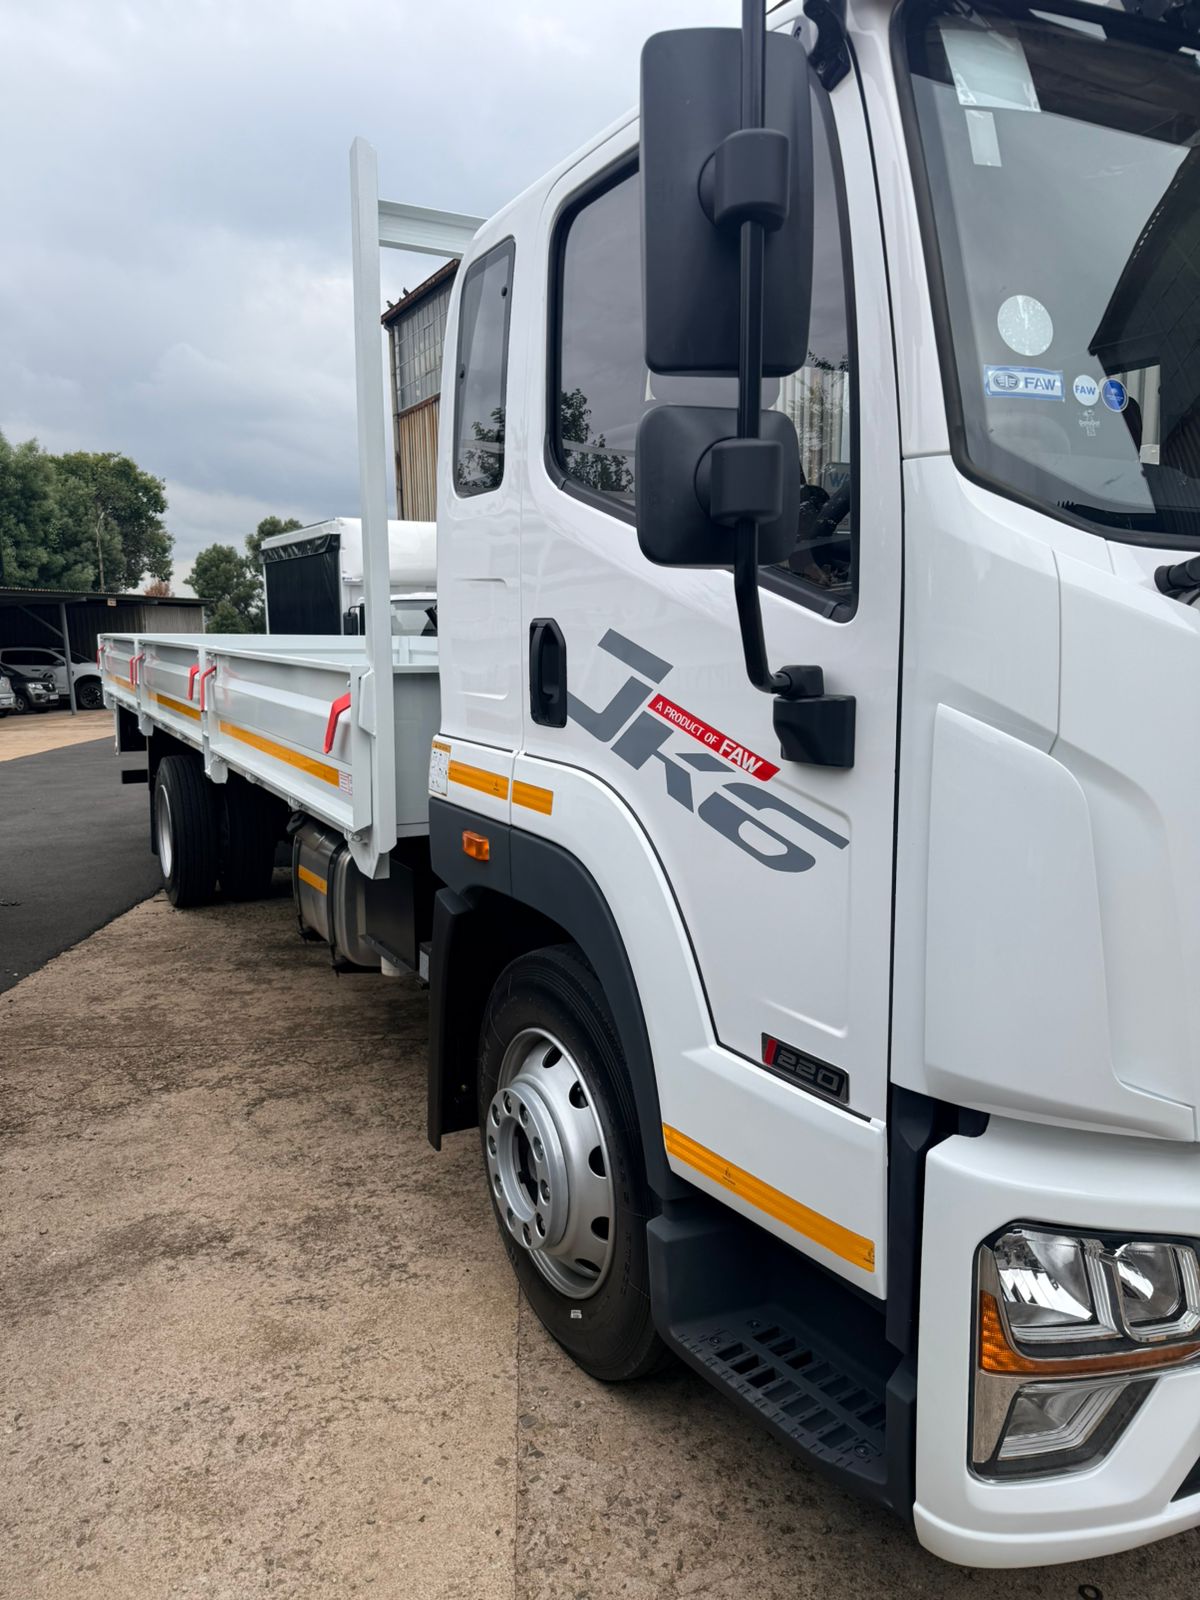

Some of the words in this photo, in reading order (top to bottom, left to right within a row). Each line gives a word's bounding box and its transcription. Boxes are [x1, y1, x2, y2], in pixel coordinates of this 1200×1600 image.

[1024, 377, 1056, 390] FAW
[1075, 385, 1096, 395] FAW
[656, 701, 663, 712] A
[664, 705, 705, 737] PRODUCT
[703, 732, 720, 745] OF
[719, 739, 763, 773] FAW
[777, 1049, 840, 1092] 220
